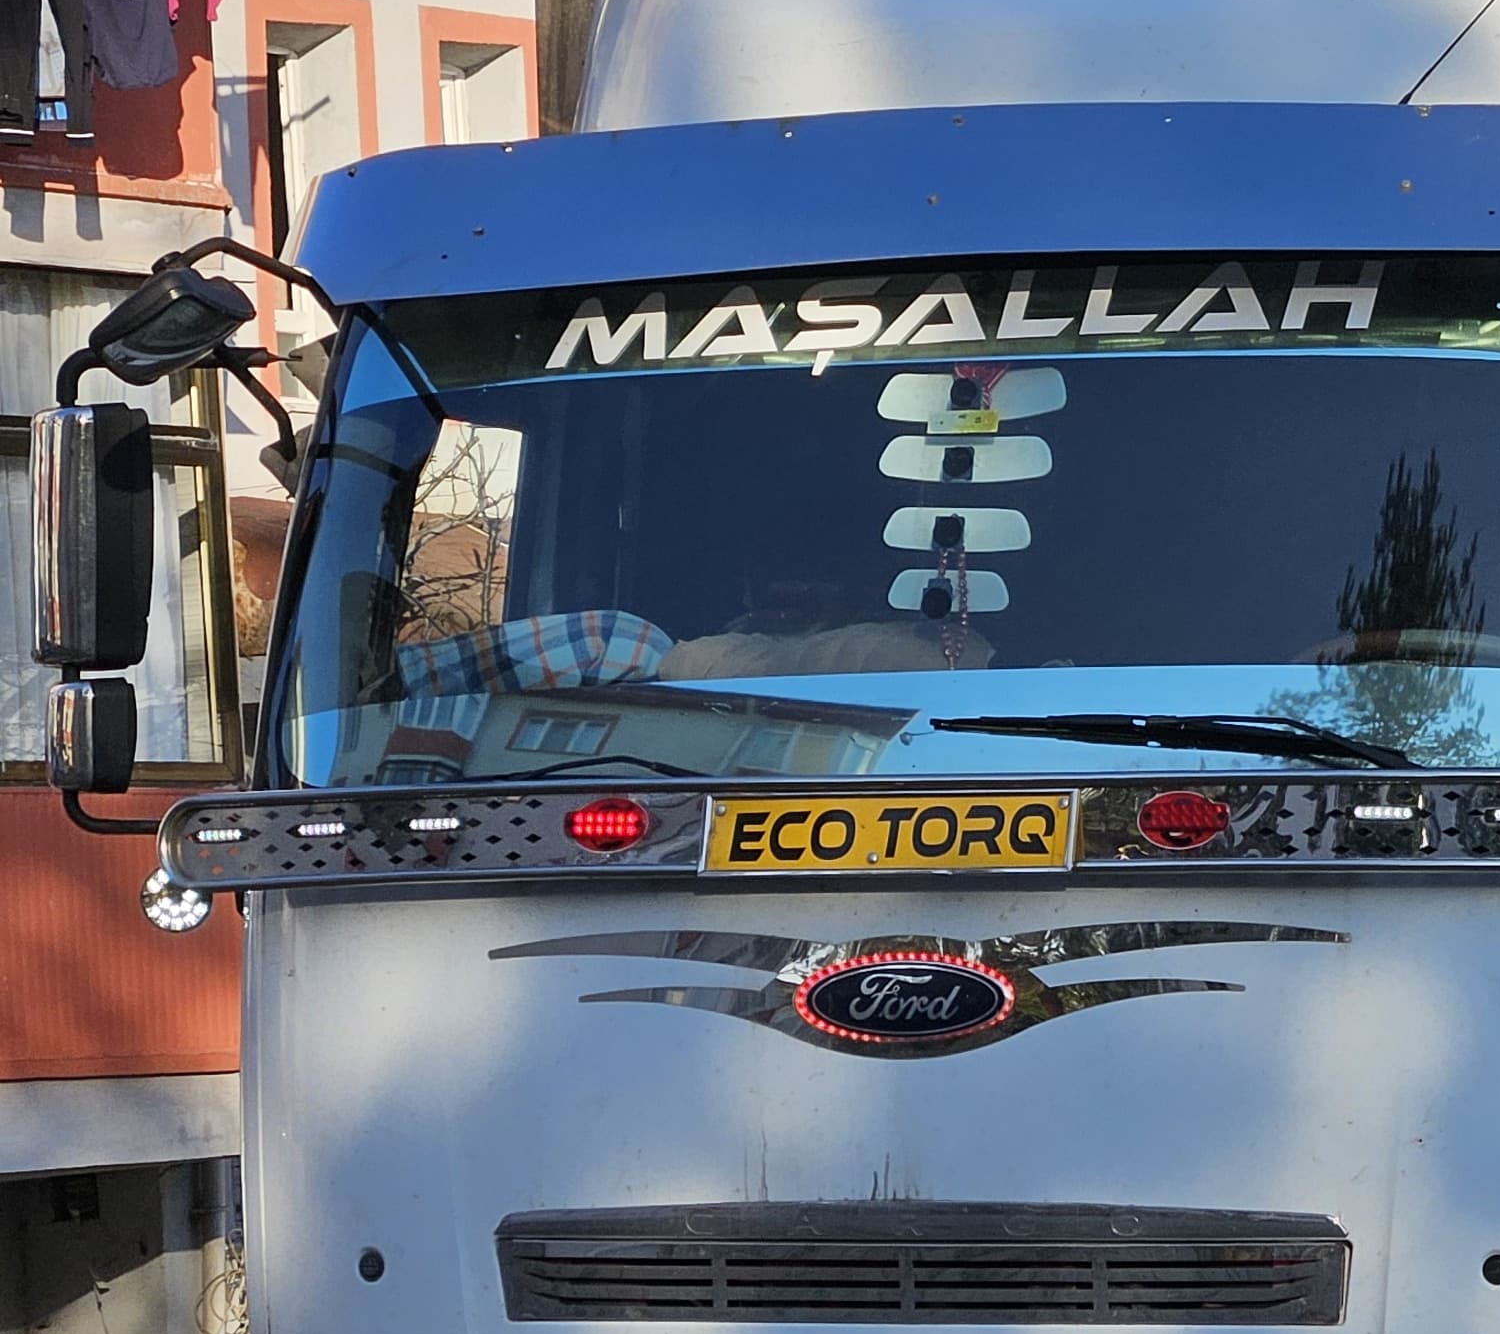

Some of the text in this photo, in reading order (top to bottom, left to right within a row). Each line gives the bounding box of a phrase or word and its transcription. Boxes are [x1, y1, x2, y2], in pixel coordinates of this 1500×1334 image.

[544, 260, 1383, 376] MAŞALLAH
[728, 803, 1056, 862] ECO TORQ
[848, 973, 961, 1022] Ford
